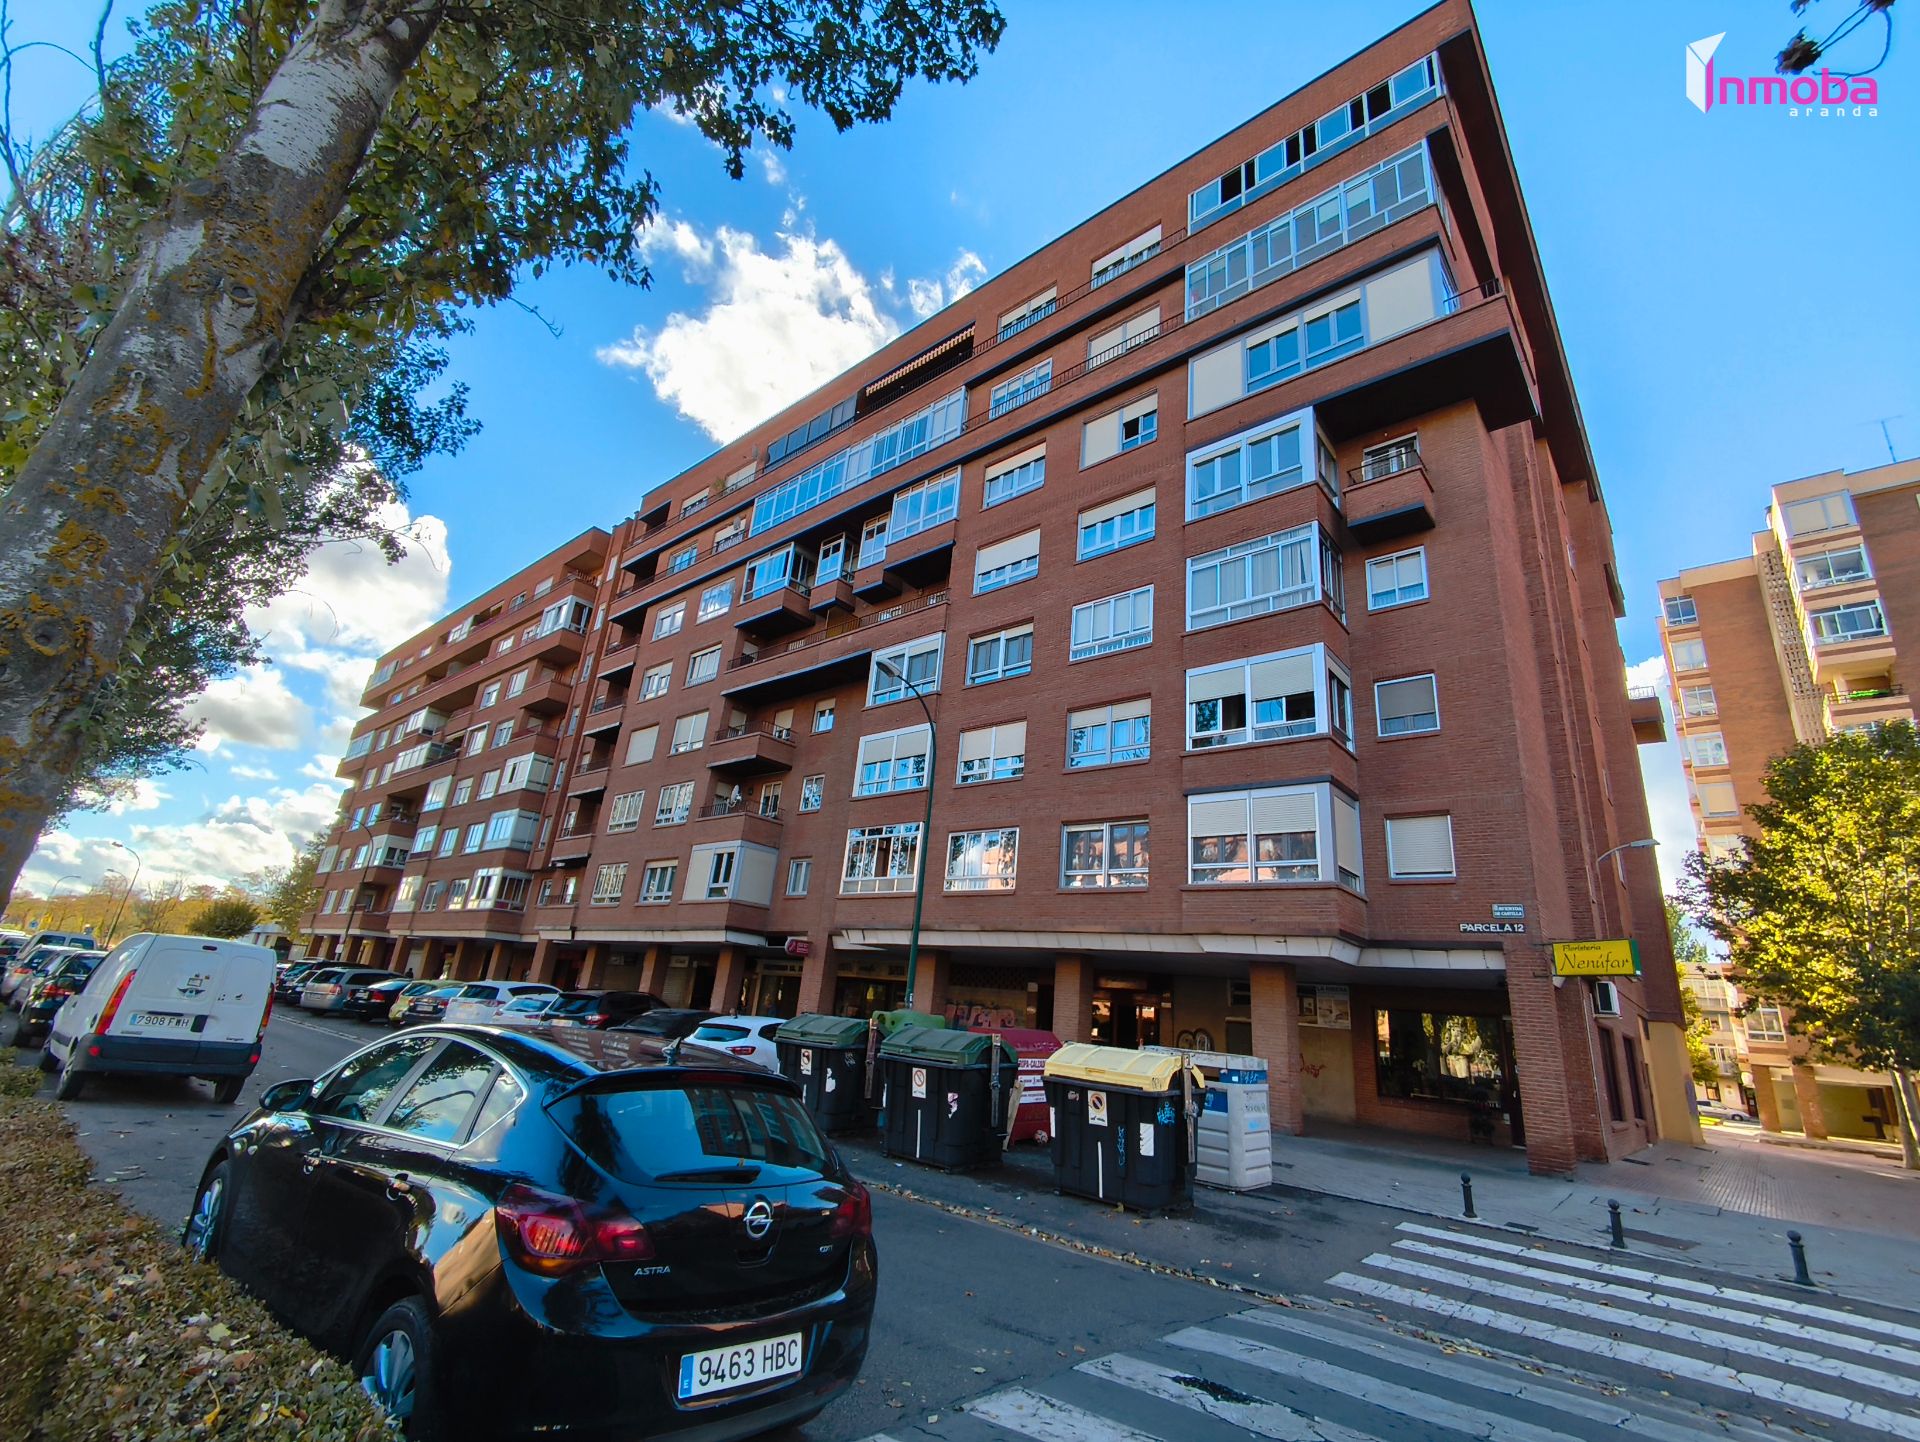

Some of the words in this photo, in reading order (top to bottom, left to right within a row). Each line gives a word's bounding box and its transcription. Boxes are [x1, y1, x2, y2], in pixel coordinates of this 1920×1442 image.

[1460, 923, 1512, 932] PARCELA
[1513, 923, 1525, 932] 12
[1560, 951, 1629, 972] Nenúfar
[137, 1015, 166, 1026] 7908
[634, 1265, 671, 1276] ASTRA
[698, 1348, 755, 1387] 9463
[762, 1339, 798, 1374] HBC
